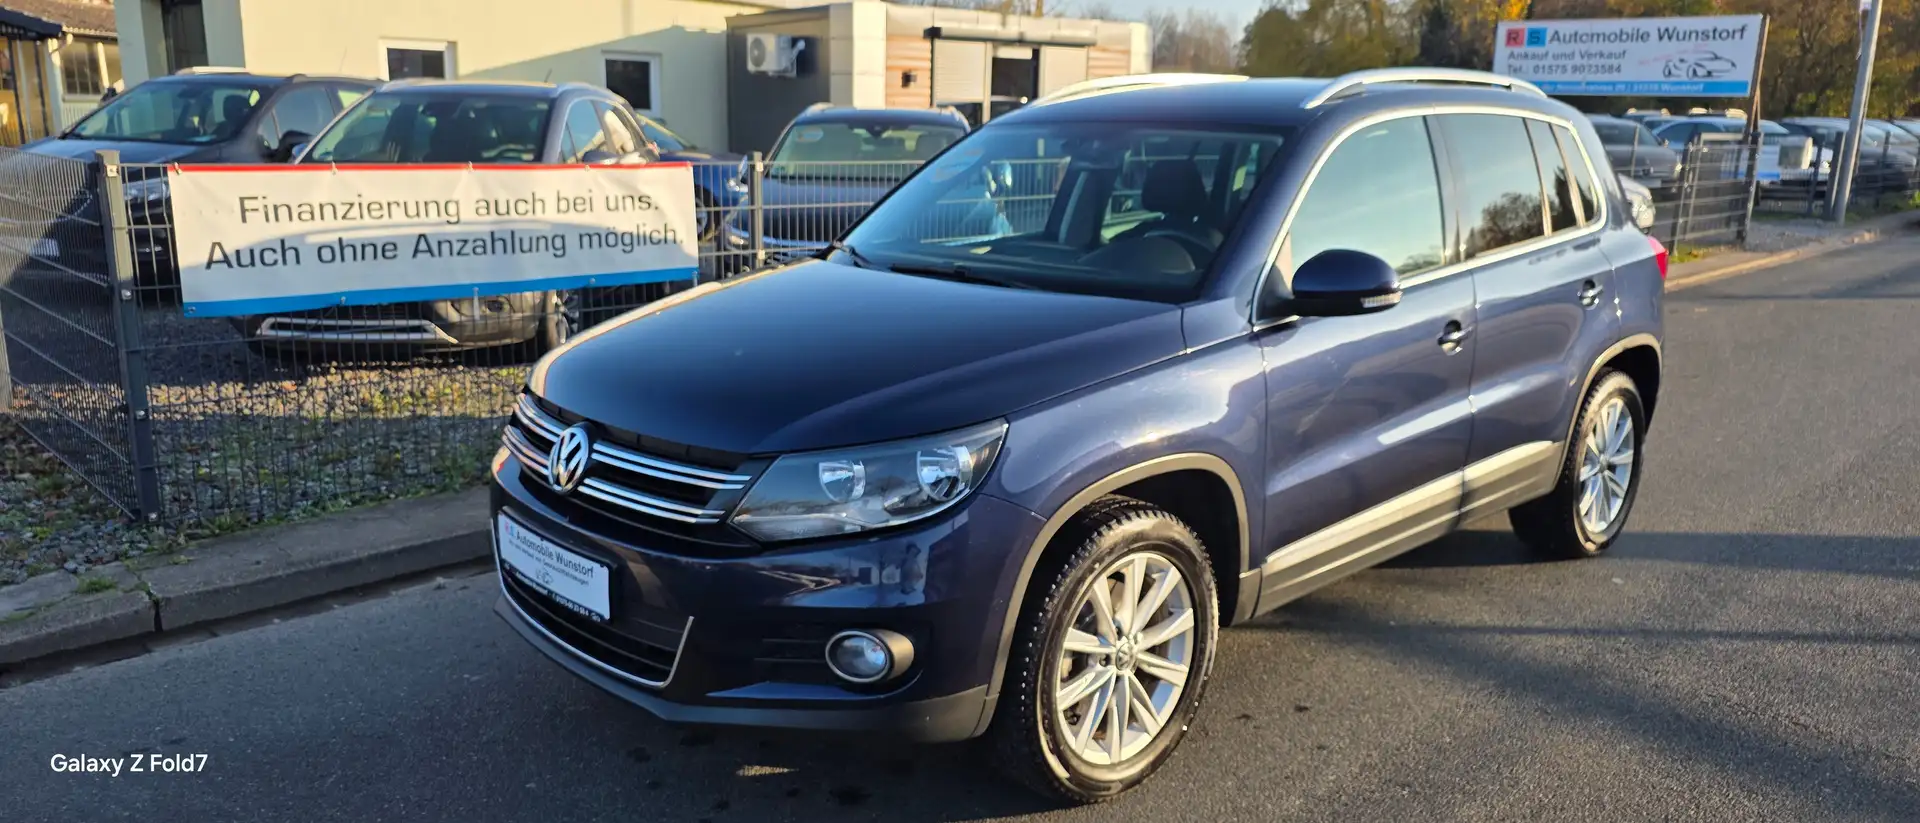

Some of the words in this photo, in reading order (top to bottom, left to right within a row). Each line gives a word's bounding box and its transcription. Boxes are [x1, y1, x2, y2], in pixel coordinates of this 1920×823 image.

[1549, 27, 1650, 45] Automobile
[1657, 23, 1748, 42] Wunstorf
[1508, 50, 1549, 60] Ankauf
[1552, 50, 1575, 60] und
[1579, 49, 1627, 60] Verkauf
[238, 194, 460, 225] Finanzierung
[475, 191, 546, 217] auch
[556, 189, 594, 214] bei
[606, 192, 659, 213] uns.
[205, 238, 301, 270] Auch
[317, 237, 399, 263] ohne
[411, 229, 566, 258] Anzahlung
[579, 222, 684, 253] möglich.
[516, 531, 554, 560] Automobile
[555, 550, 594, 578] Wunstorf
